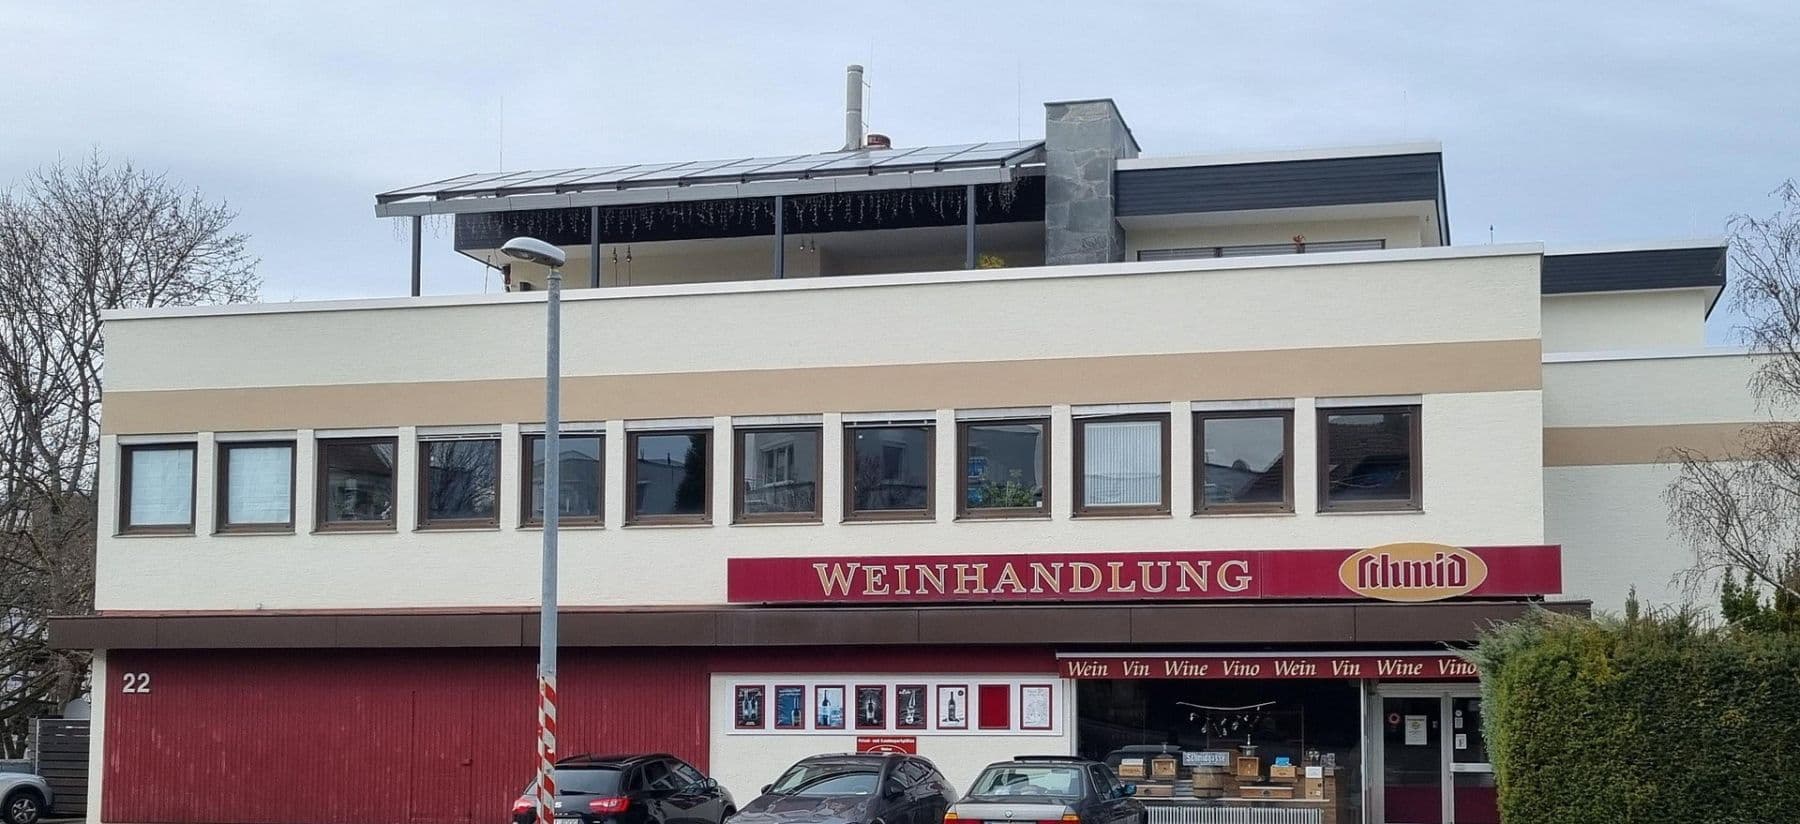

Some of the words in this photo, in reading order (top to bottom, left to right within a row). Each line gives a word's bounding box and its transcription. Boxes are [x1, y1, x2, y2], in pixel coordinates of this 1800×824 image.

[812, 559, 1253, 596] WEINHANDLUNG
[1067, 660, 1109, 677] Wein
[1122, 660, 1150, 677] Vin
[1164, 660, 1208, 676] Wine
[1222, 660, 1260, 676] Vino
[1274, 660, 1317, 676] Wein
[1331, 660, 1361, 676] Vin
[1376, 659, 1423, 676] Wine
[1438, 658, 1477, 675] Vino
[122, 672, 151, 693] 22
